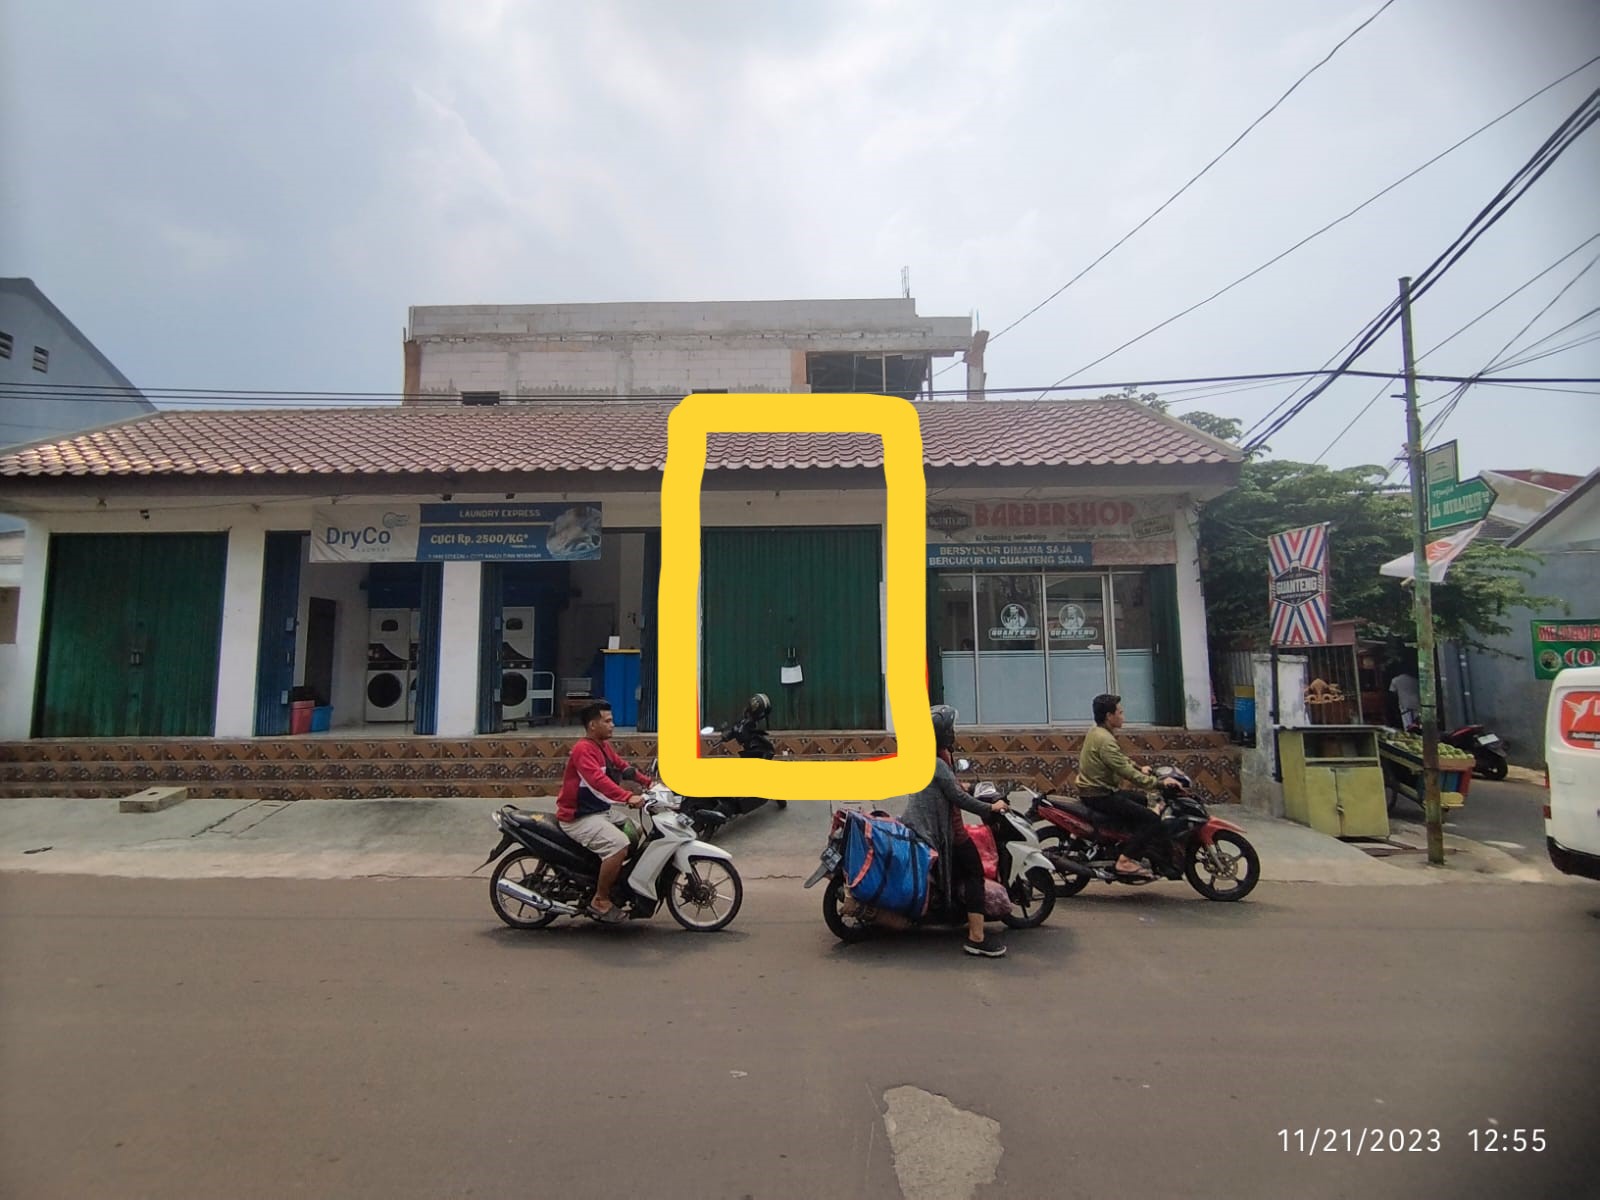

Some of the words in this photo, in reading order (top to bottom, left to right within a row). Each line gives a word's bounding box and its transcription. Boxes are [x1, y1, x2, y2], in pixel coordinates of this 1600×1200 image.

[459, 509, 500, 518] LAUNDRY
[501, 509, 541, 517] EXPRESS
[975, 502, 1137, 528] BARBERSHOP
[326, 526, 391, 549] DryCo
[430, 534, 455, 545] CUCI
[457, 534, 474, 546] Rp.
[940, 545, 1001, 556] BERSYUKUR
[1003, 545, 1044, 555] DIMANA
[1046, 545, 1073, 554] SAJA
[928, 556, 985, 566] BERCUKUR
[986, 556, 997, 565] DI
[999, 556, 1056, 565] GUANTENG
[1057, 556, 1085, 565] SAJA
